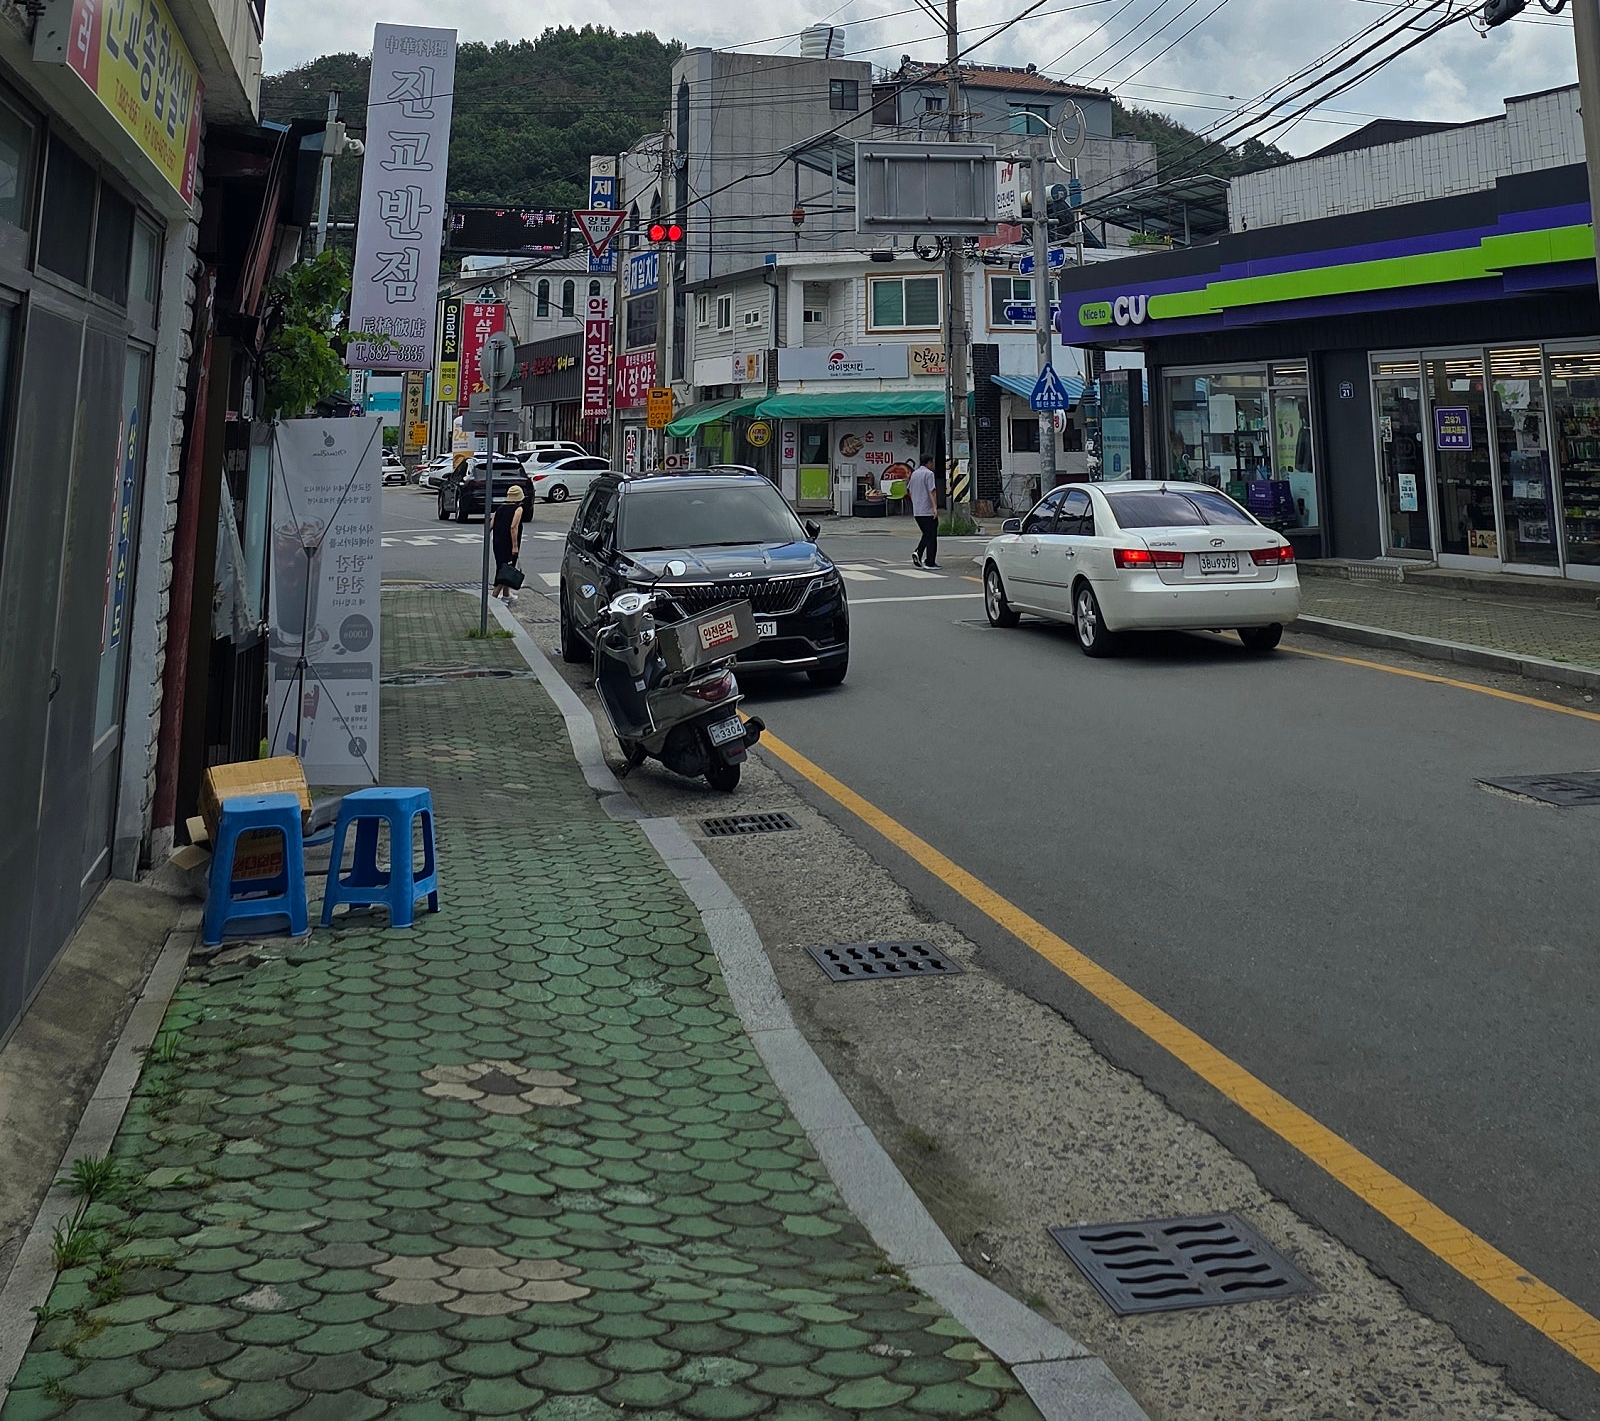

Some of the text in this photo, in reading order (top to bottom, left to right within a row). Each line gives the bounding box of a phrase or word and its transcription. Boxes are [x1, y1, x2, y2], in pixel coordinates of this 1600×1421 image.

[385, 35, 449, 58] 中華料理
[371, 66, 435, 304] 진교반점
[588, 216, 611, 225] 양보
[588, 298, 609, 319] 약
[1083, 295, 1146, 326] Nice to CU
[444, 305, 458, 354] emart24
[356, 343, 425, 362] T.882-3335
[585, 323, 608, 406] 시장약국
[828, 363, 863, 372] 아이벗치킨
[616, 364, 657, 397] 시장약
[1342, 389, 1350, 397] 21
[784, 431, 795, 459] 오뎅
[865, 430, 893, 443] 순대
[865, 451, 894, 464] 떡볶이
[703, 620, 733, 641] 안전운전
